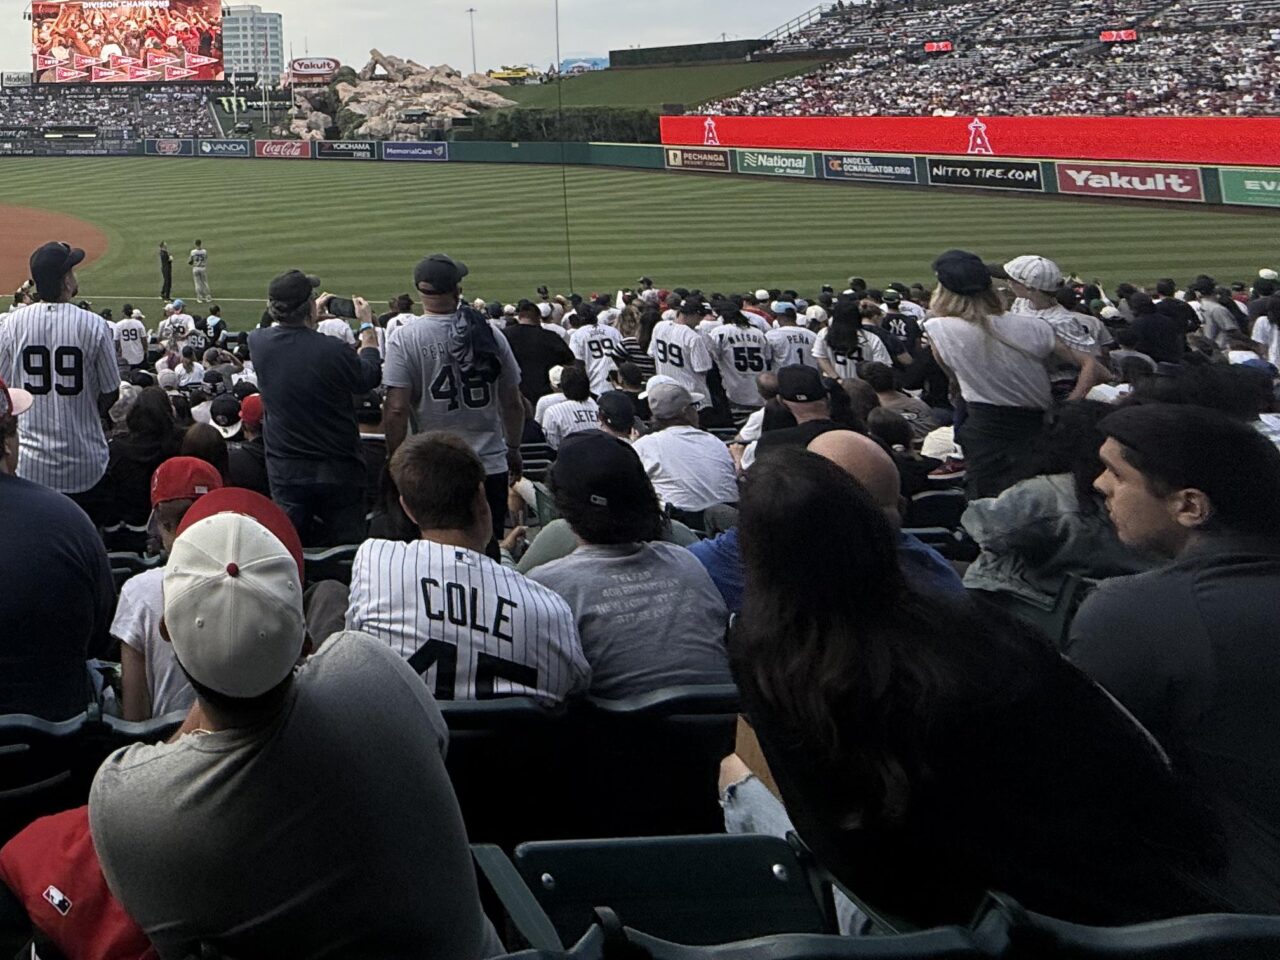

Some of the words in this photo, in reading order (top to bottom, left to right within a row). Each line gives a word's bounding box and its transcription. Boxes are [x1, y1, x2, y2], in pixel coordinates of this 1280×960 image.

[121, 0, 170, 8] CHAMPIONS
[297, 61, 333, 70] Yakult
[386, 147, 433, 155] MemorialCare
[683, 152, 725, 162] PECHANGA
[757, 153, 807, 168] National
[933, 166, 970, 178] NITTO
[974, 168, 1038, 182] TIRE.COM
[1065, 169, 1193, 193] Yakult
[1244, 180, 1280, 191] EV
[122, 328, 138, 341] 99
[588, 338, 615, 360] 99
[656, 339, 685, 368] 99
[733, 346, 764, 372] 55
[22, 345, 84, 396] 99
[420, 577, 518, 643] COLE
